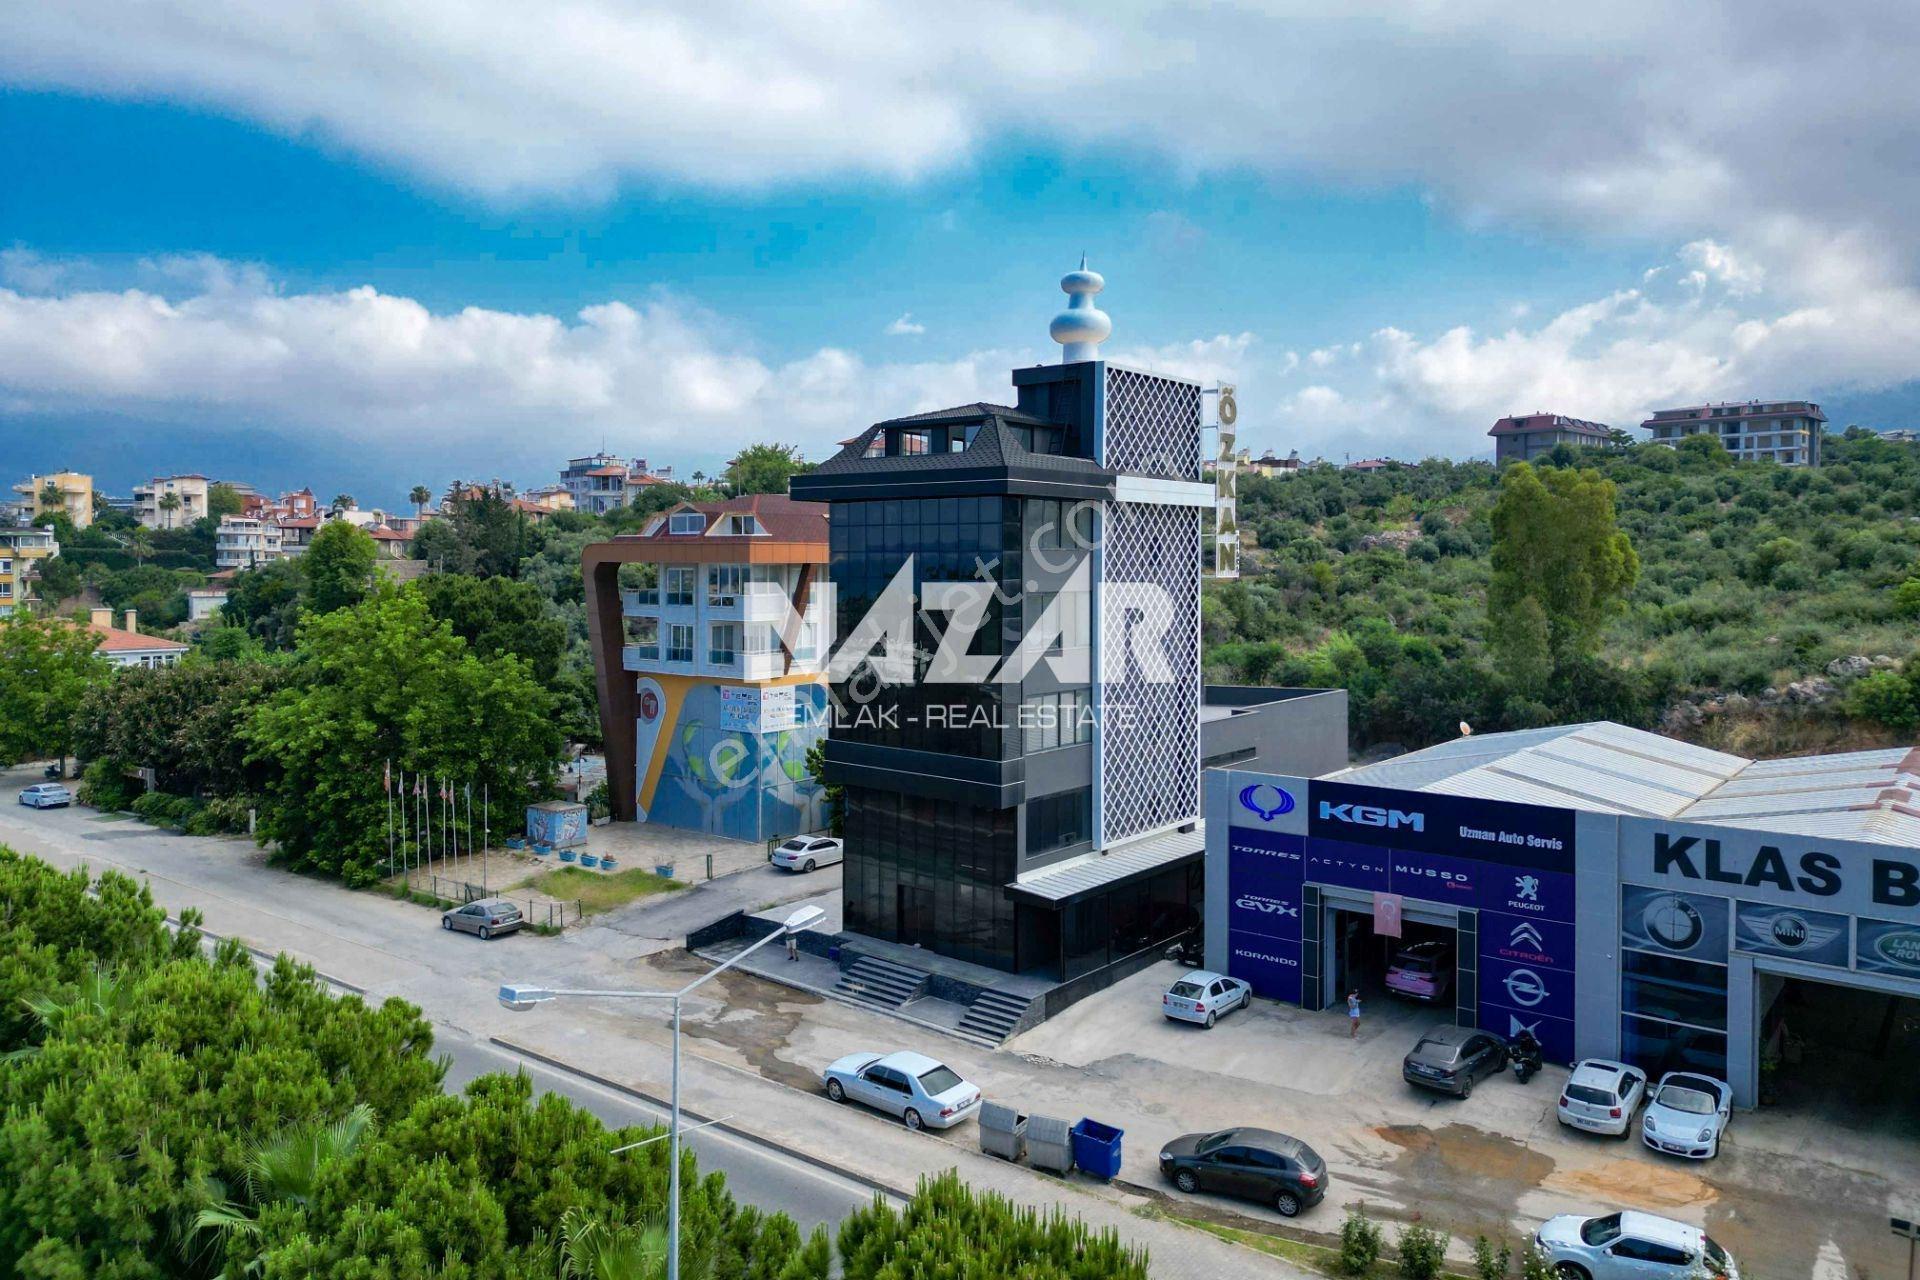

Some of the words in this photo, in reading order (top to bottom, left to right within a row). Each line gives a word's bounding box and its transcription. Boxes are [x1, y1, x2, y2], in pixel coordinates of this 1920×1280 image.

[1219, 387, 1236, 571] ÖZKAN
[1320, 801, 1424, 832] KGM
[1459, 826, 1496, 842] Uzman
[1498, 830, 1525, 846] Auto
[1527, 834, 1563, 851] Servis
[1232, 845, 1301, 860] TORRES
[1310, 857, 1384, 873] ACTYON
[1654, 833, 1842, 896] KLAS
[1395, 865, 1468, 882] MUSSO
[1243, 894, 1289, 906] TORRES
[1508, 900, 1545, 912] PEUGEOT
[1774, 926, 1805, 941] MINI
[1235, 949, 1298, 967] KORANDO
